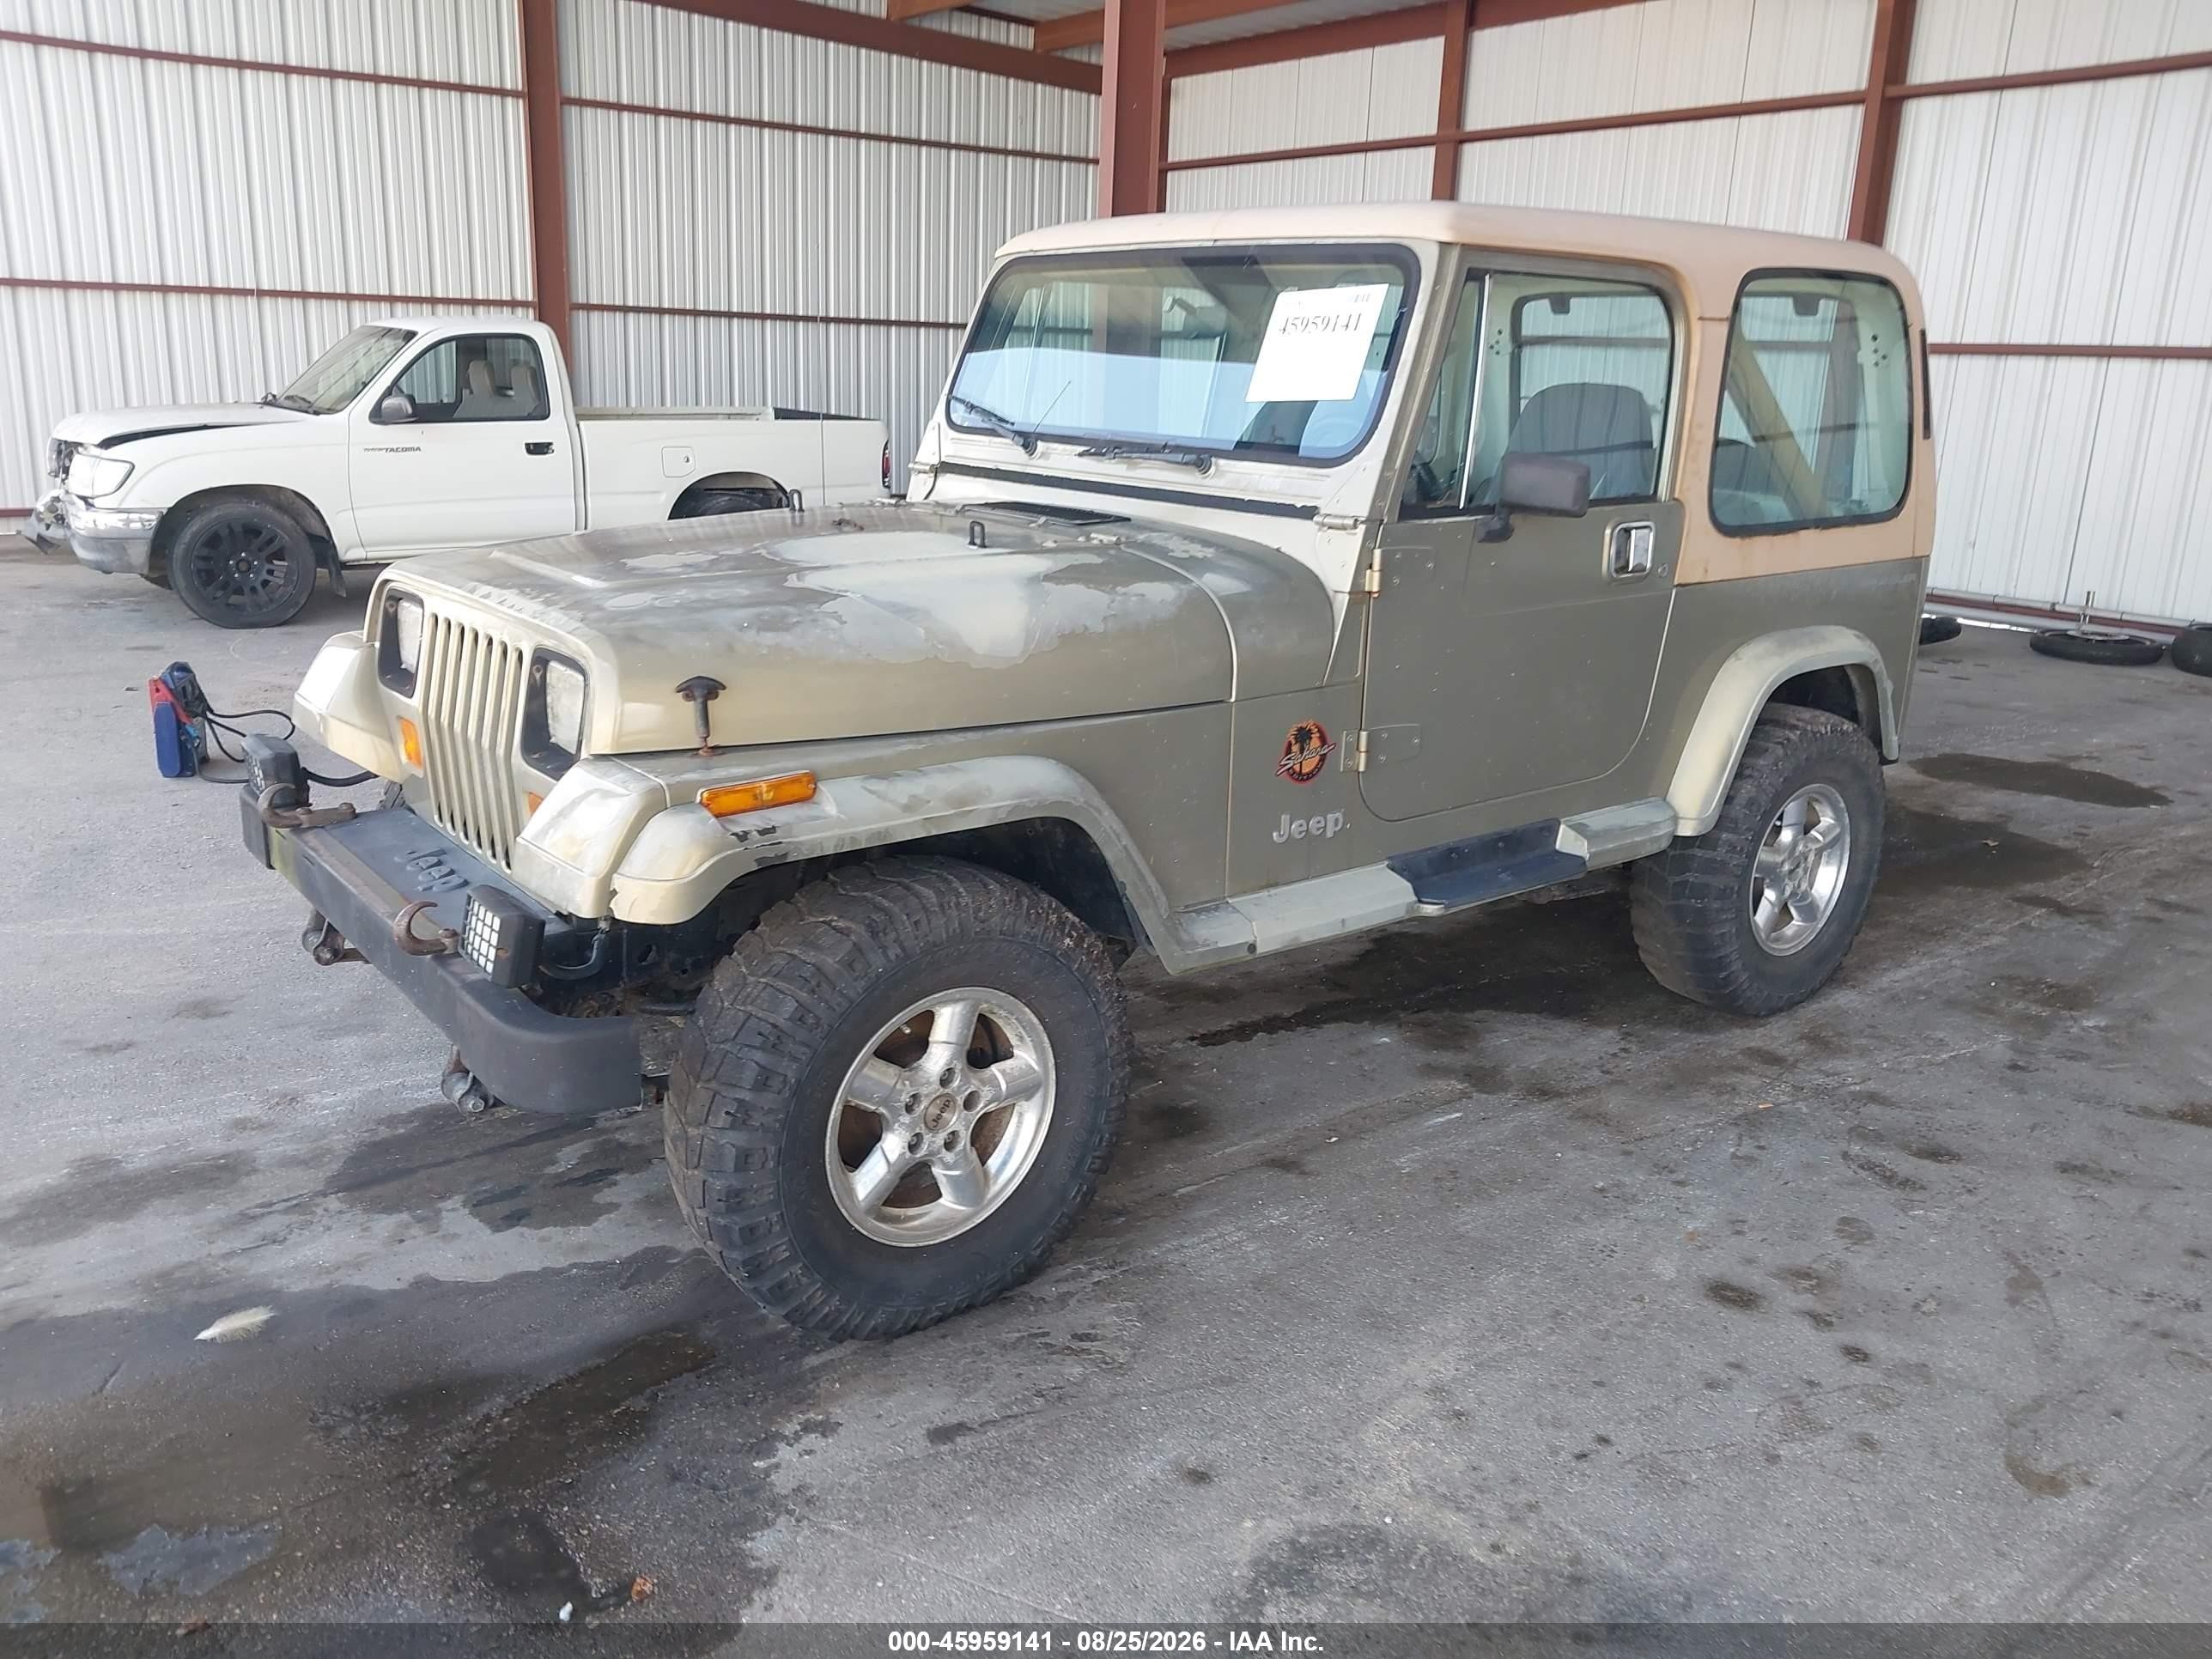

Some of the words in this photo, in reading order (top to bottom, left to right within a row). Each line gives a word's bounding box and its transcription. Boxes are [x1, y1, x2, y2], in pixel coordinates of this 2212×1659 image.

[1274, 742, 1337, 777] Sahara
[1273, 811, 1344, 843] Jeep
[394, 848, 470, 893] Jeep
[931, 1099, 951, 1128] Jeep
